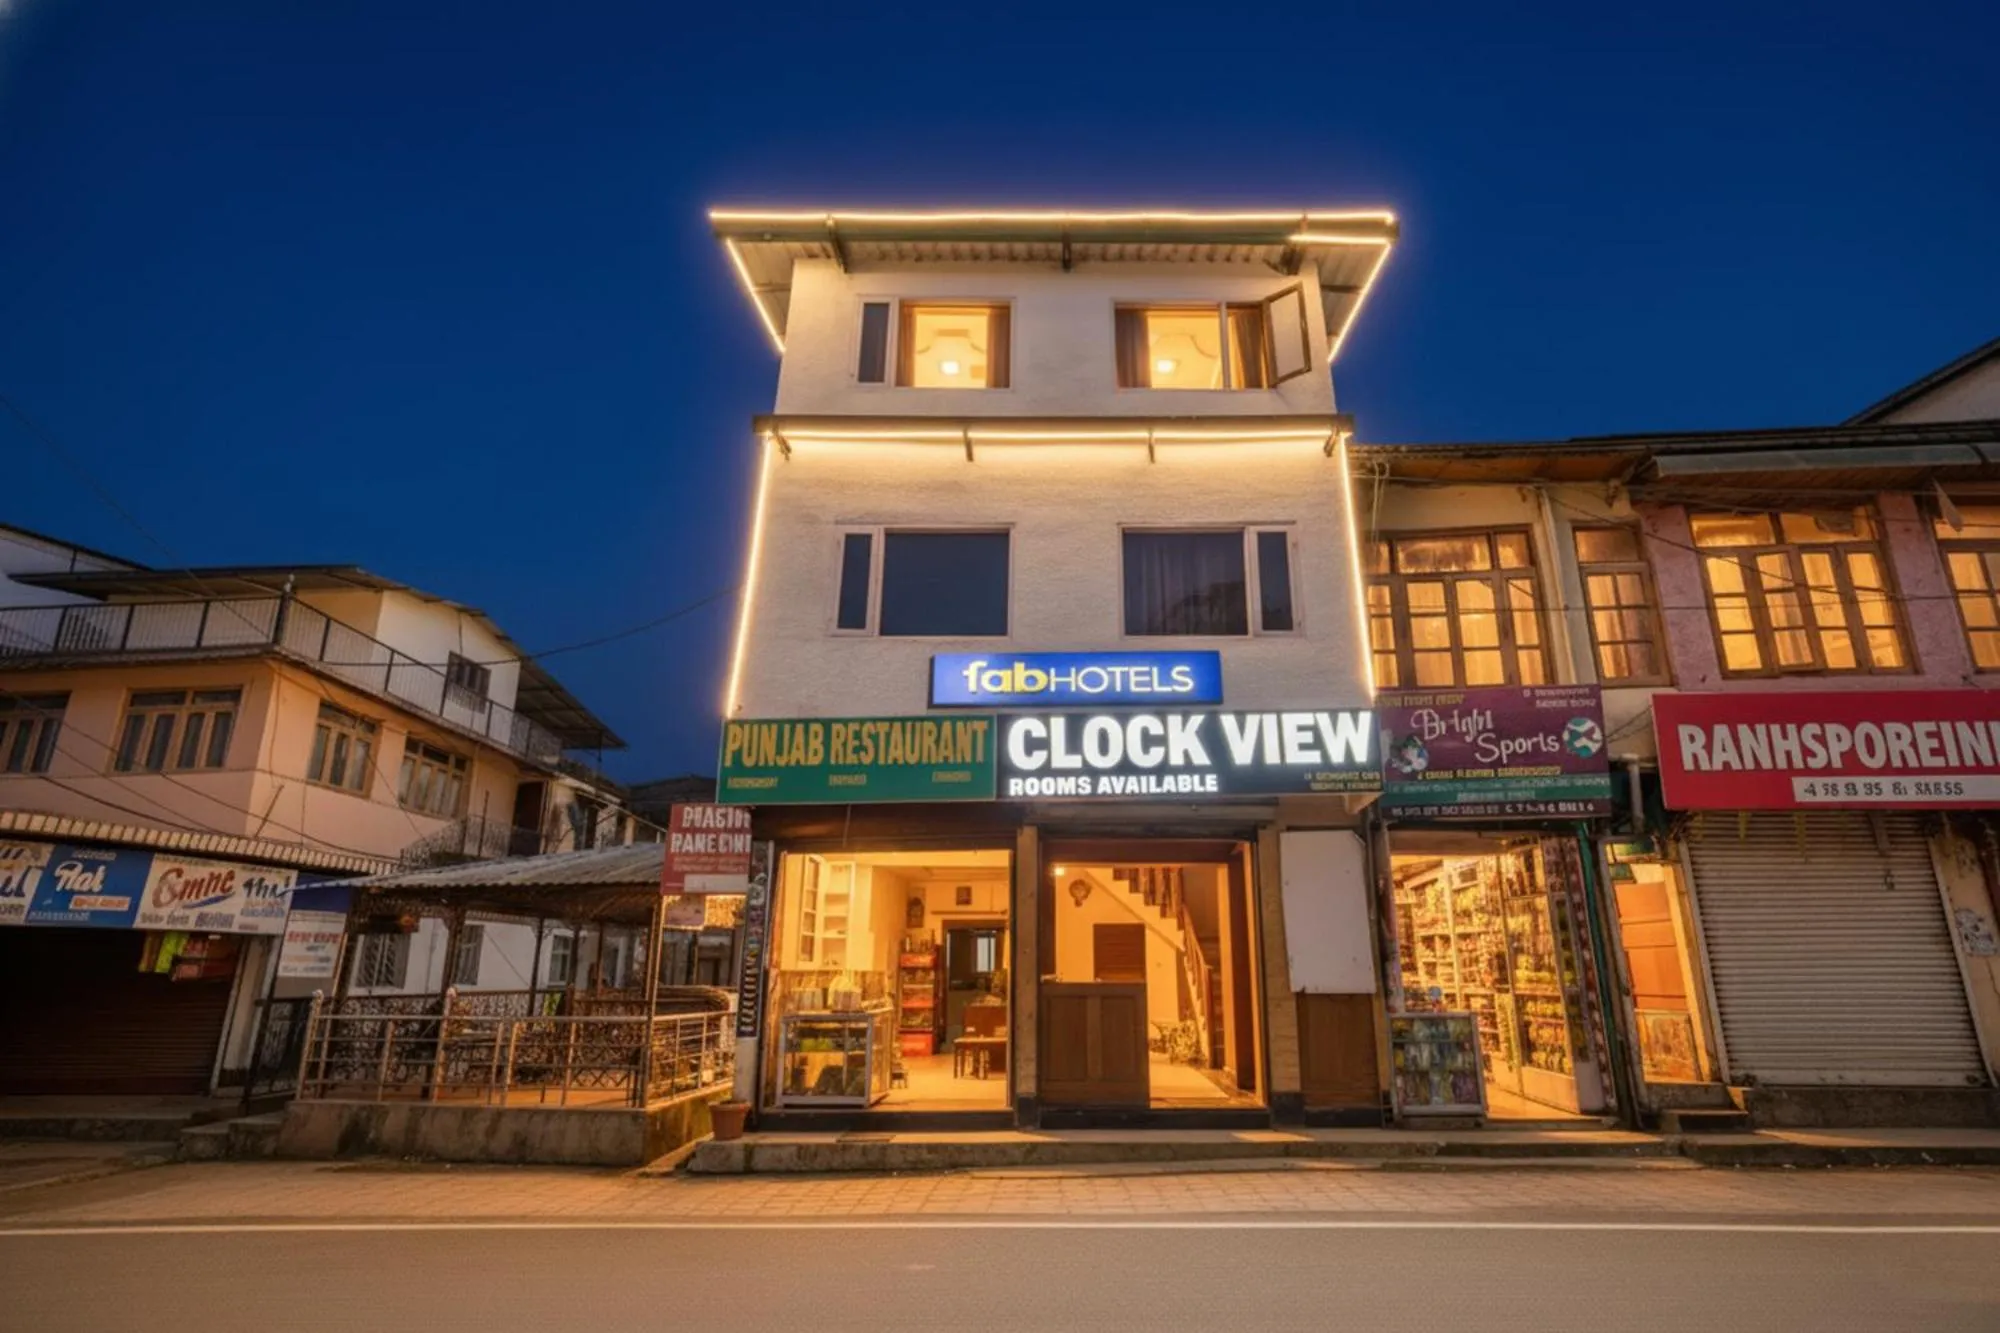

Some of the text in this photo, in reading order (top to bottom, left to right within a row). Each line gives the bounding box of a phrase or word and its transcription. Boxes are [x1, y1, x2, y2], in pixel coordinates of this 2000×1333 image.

[963, 661, 1194, 693] fabHOTELS
[724, 721, 988, 767] PUNJAB RESTAURANT
[1007, 711, 1372, 770] CLOCK VIEW
[1474, 732, 1560, 764] Sports
[1009, 774, 1218, 796] ROOMS AVAILABLE
